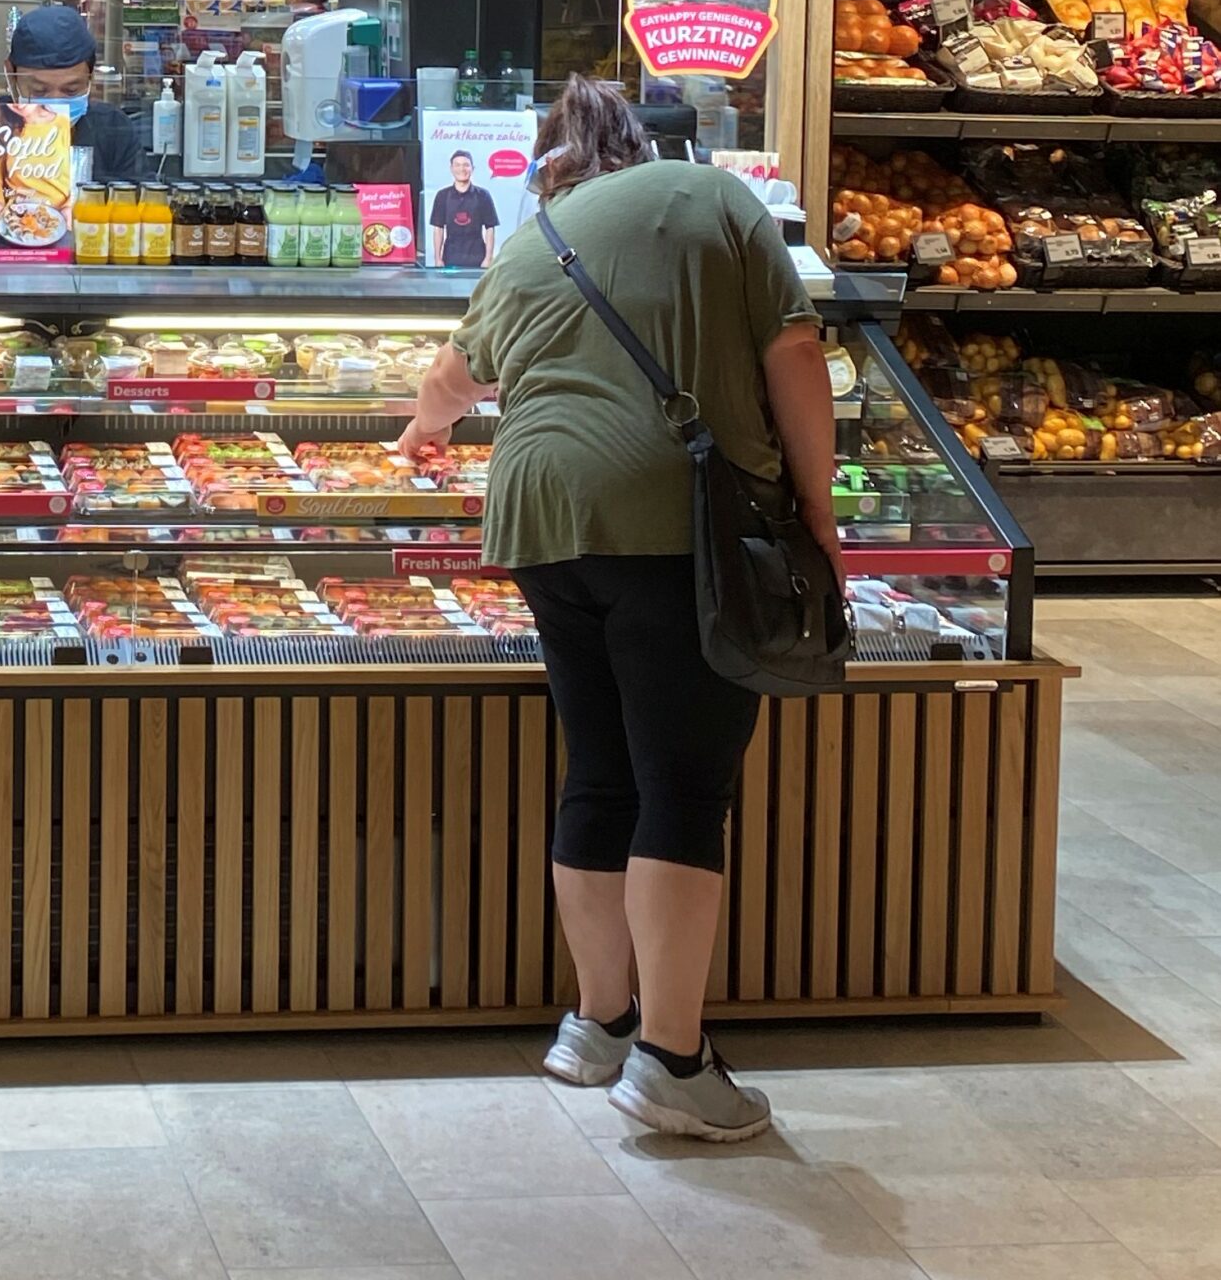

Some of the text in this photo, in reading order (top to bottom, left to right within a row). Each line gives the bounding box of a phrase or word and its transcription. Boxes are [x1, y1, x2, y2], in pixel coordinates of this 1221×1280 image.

[640, 11, 697, 27] EATHAPPY
[645, 26, 758, 50] KURZTRIP
[657, 48, 746, 68] GEWINNEN!
[431, 129, 531, 141] Marktkasse zahlen
[9, 156, 63, 179] Food
[113, 385, 169, 397] Desserts
[401, 557, 481, 570] Fresh Sushi
